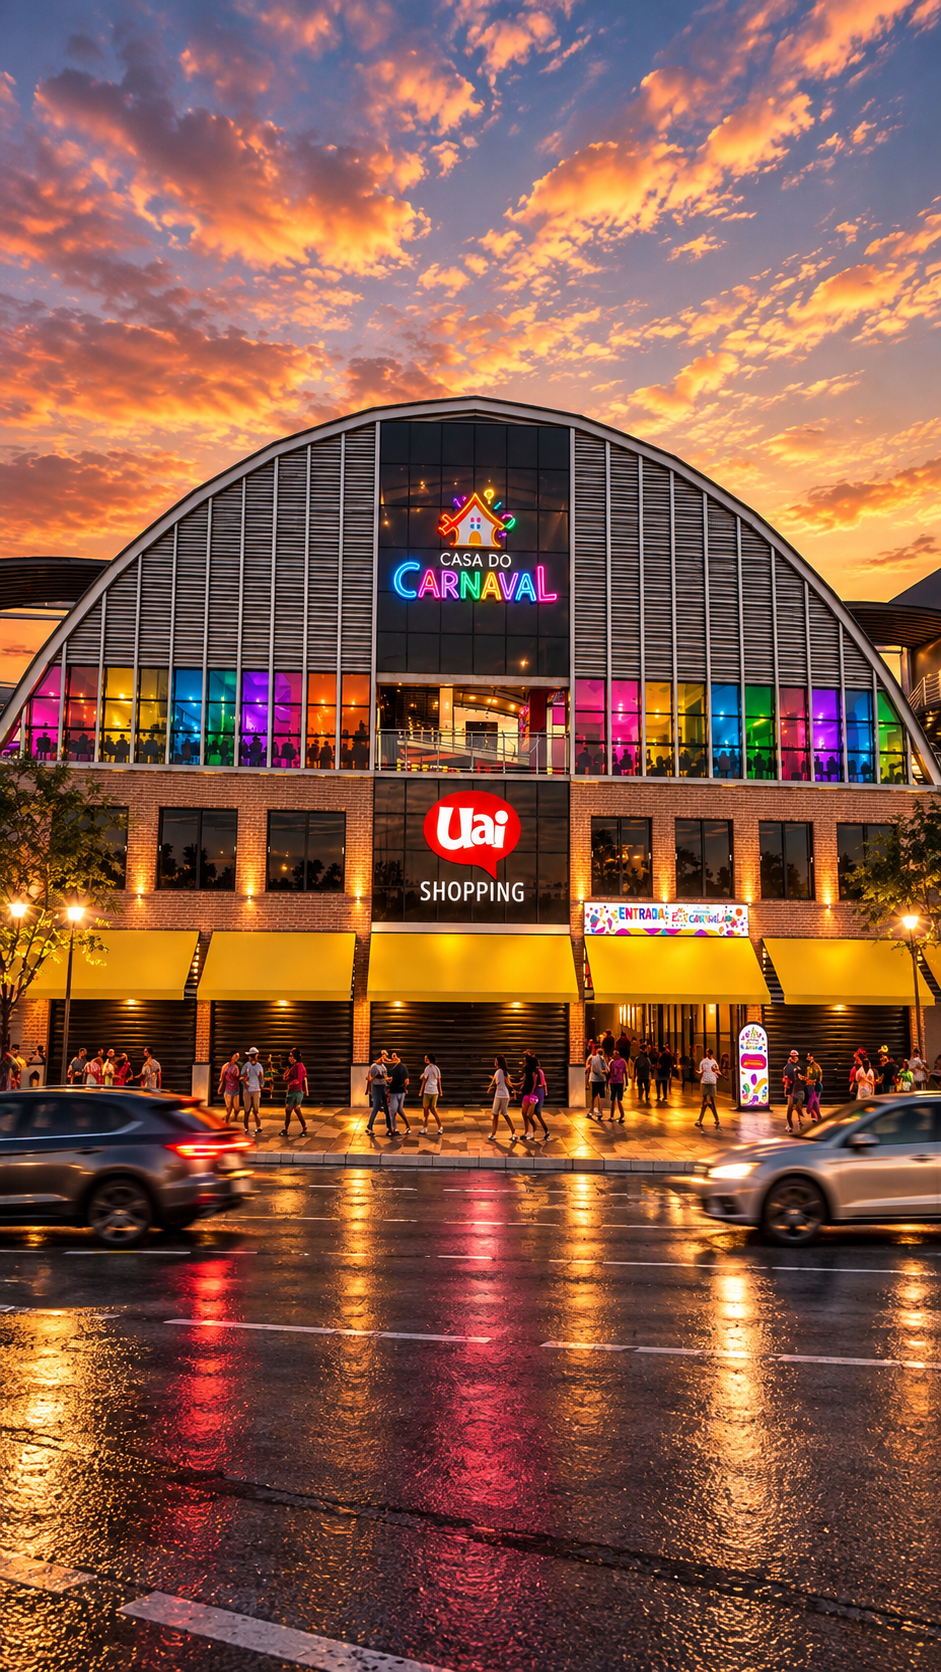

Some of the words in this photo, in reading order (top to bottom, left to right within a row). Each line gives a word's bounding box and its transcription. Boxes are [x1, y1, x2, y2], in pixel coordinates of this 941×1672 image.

[440, 553, 483, 567] CASA
[488, 555, 512, 568] DO
[393, 562, 557, 601] CARNAVAL
[436, 806, 509, 850] Uai
[420, 881, 525, 902] SHOPPING
[618, 907, 664, 920] ENTRADA
